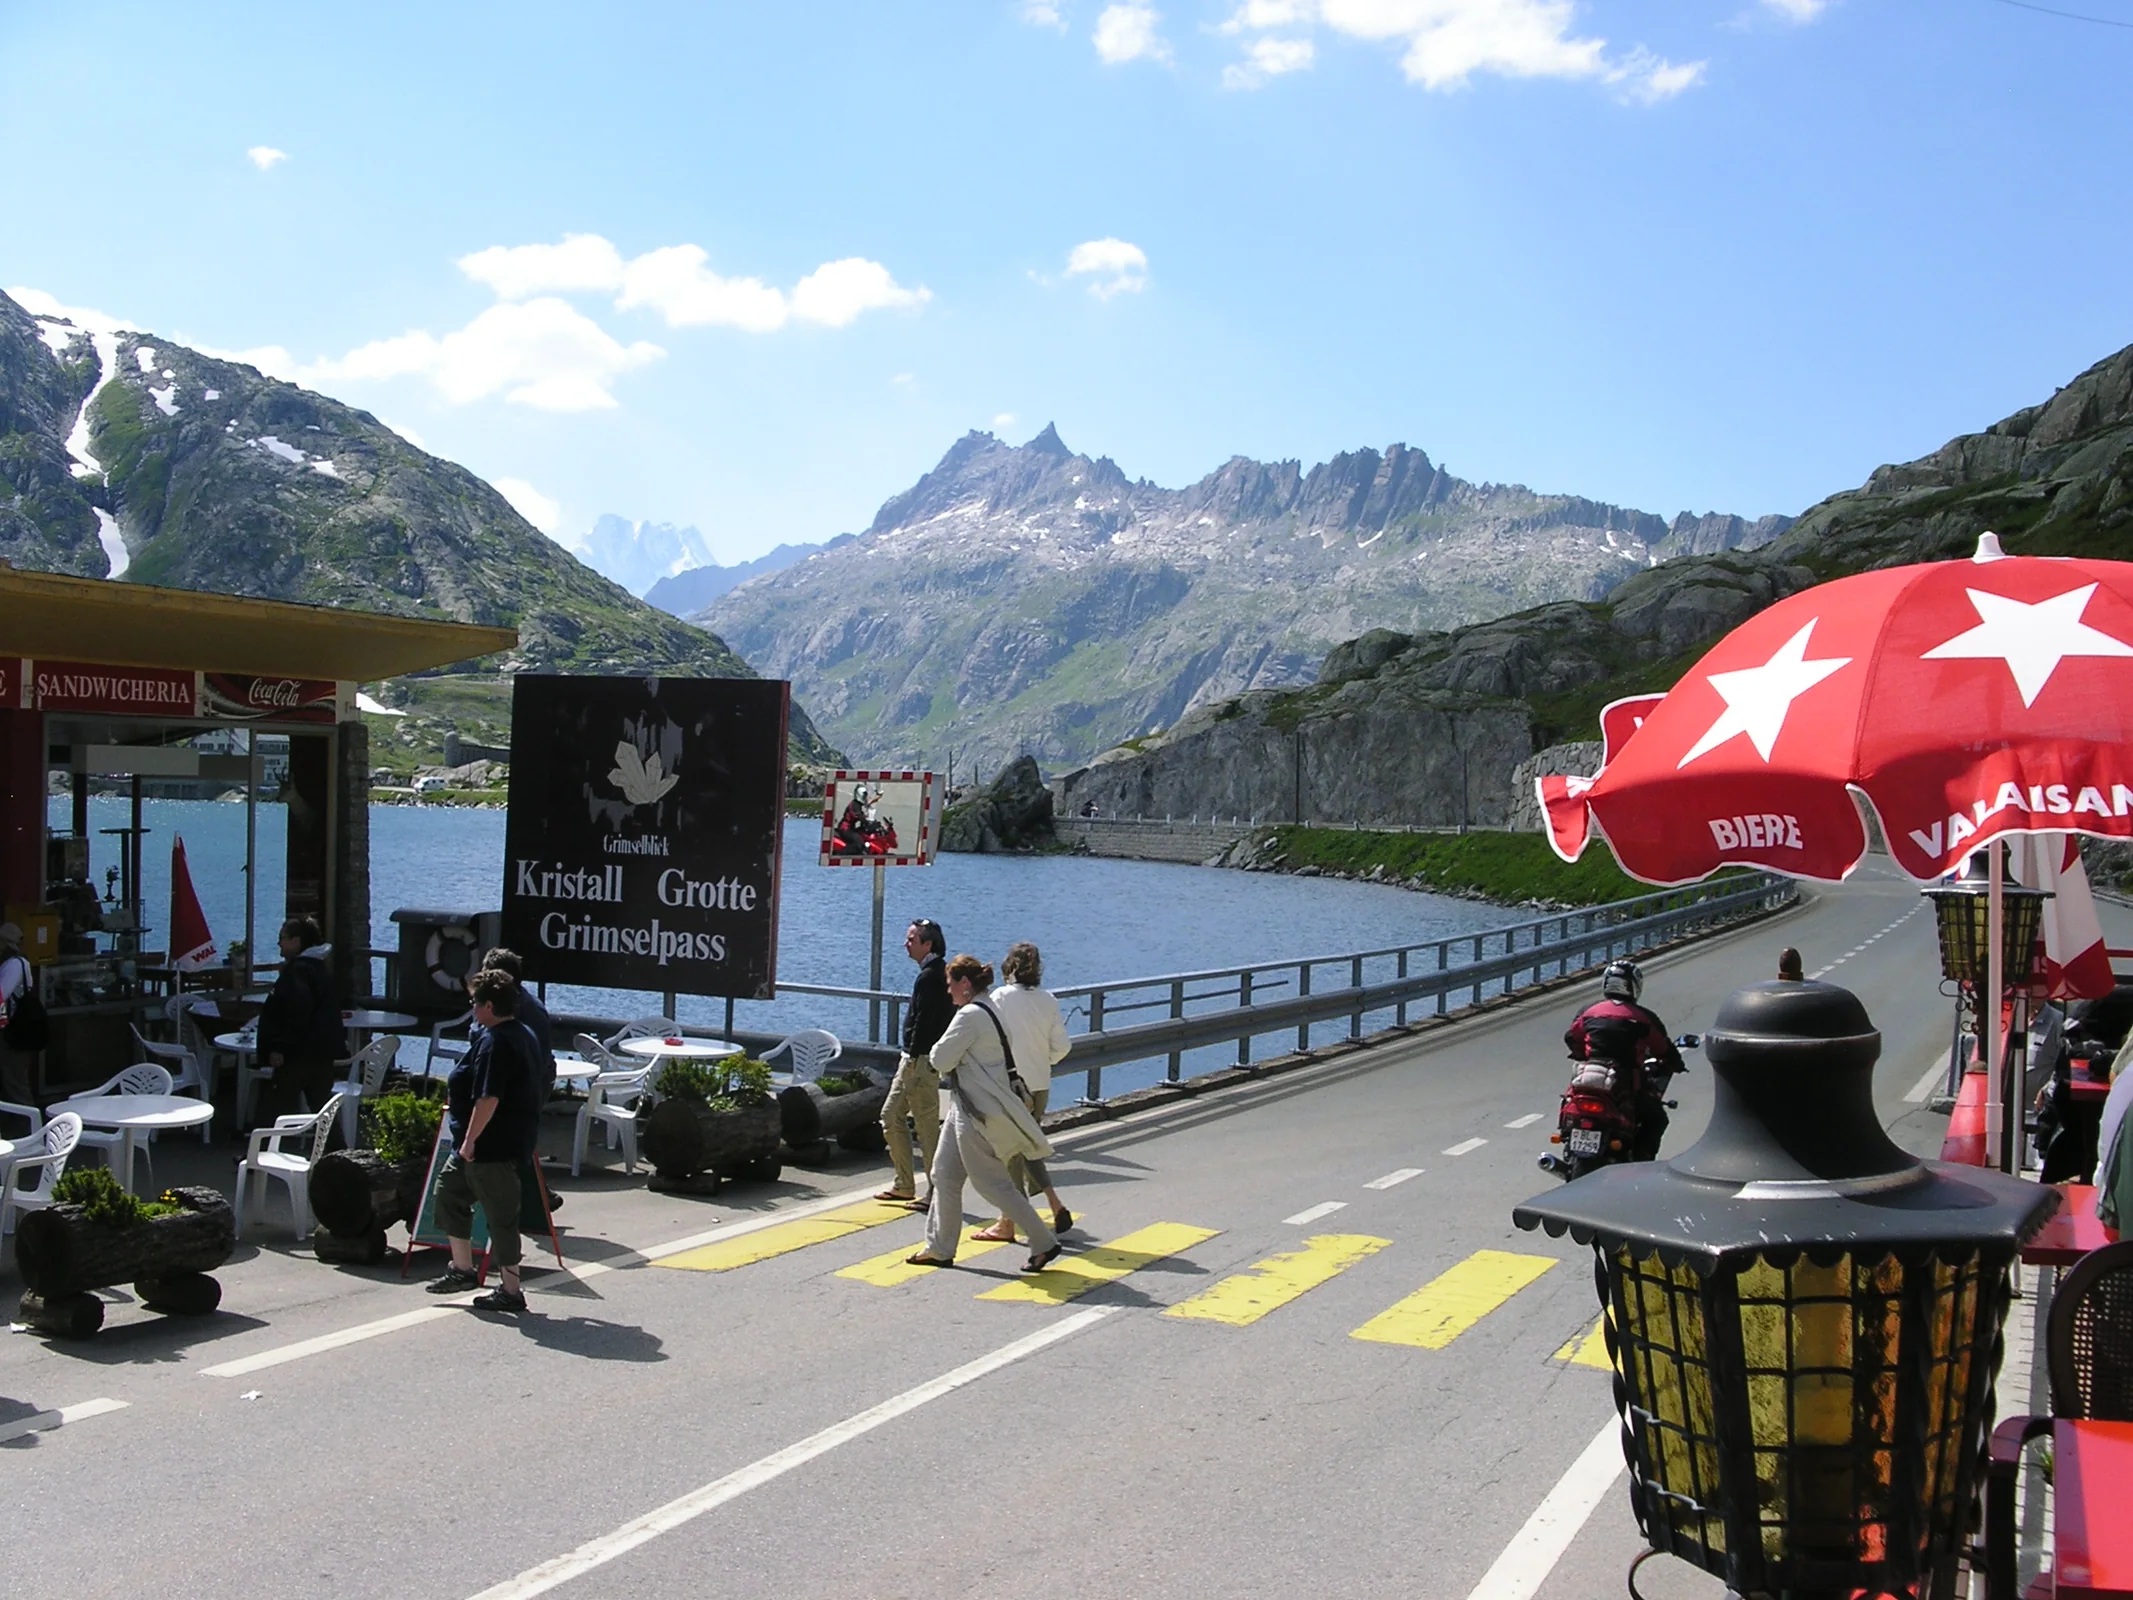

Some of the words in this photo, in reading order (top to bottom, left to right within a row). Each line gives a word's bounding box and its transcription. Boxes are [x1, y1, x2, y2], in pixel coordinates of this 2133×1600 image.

[37, 672, 190, 703] SANDWICHERIA
[602, 833, 671, 857] Grimselblick
[1708, 813, 1804, 851] BIERE
[515, 859, 624, 902] Kristall
[657, 868, 758, 912] Grotte
[539, 911, 727, 966] Grimselpass
